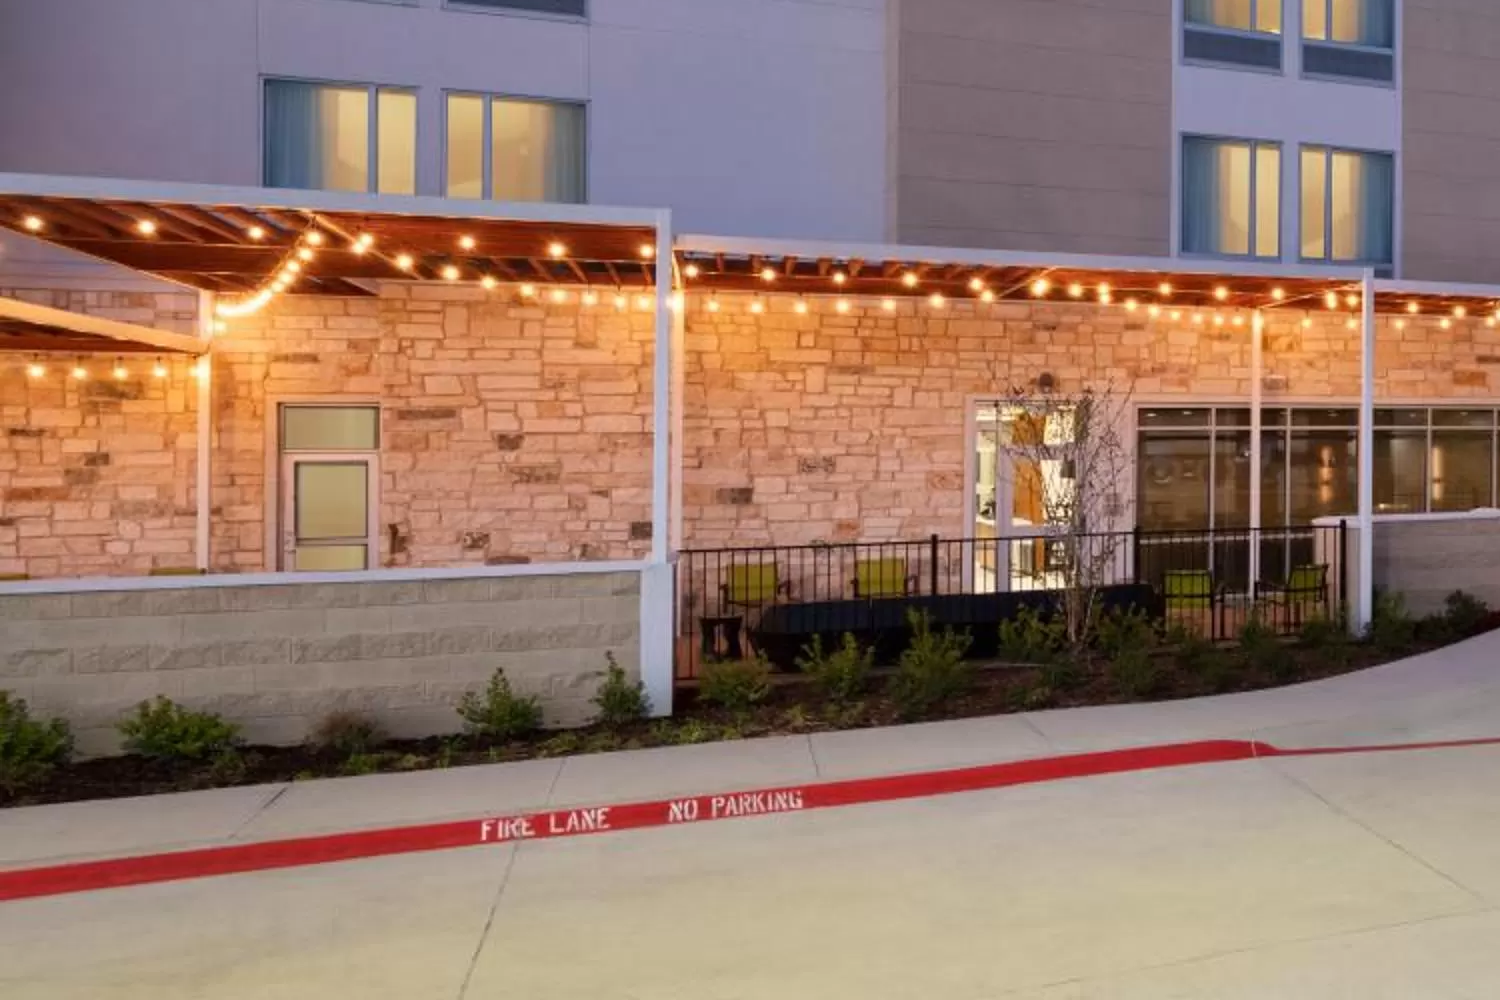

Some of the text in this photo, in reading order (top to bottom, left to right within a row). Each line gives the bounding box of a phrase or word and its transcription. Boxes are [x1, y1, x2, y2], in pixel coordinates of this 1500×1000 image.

[480, 791, 804, 842] FIRE LANE NO PARKING
